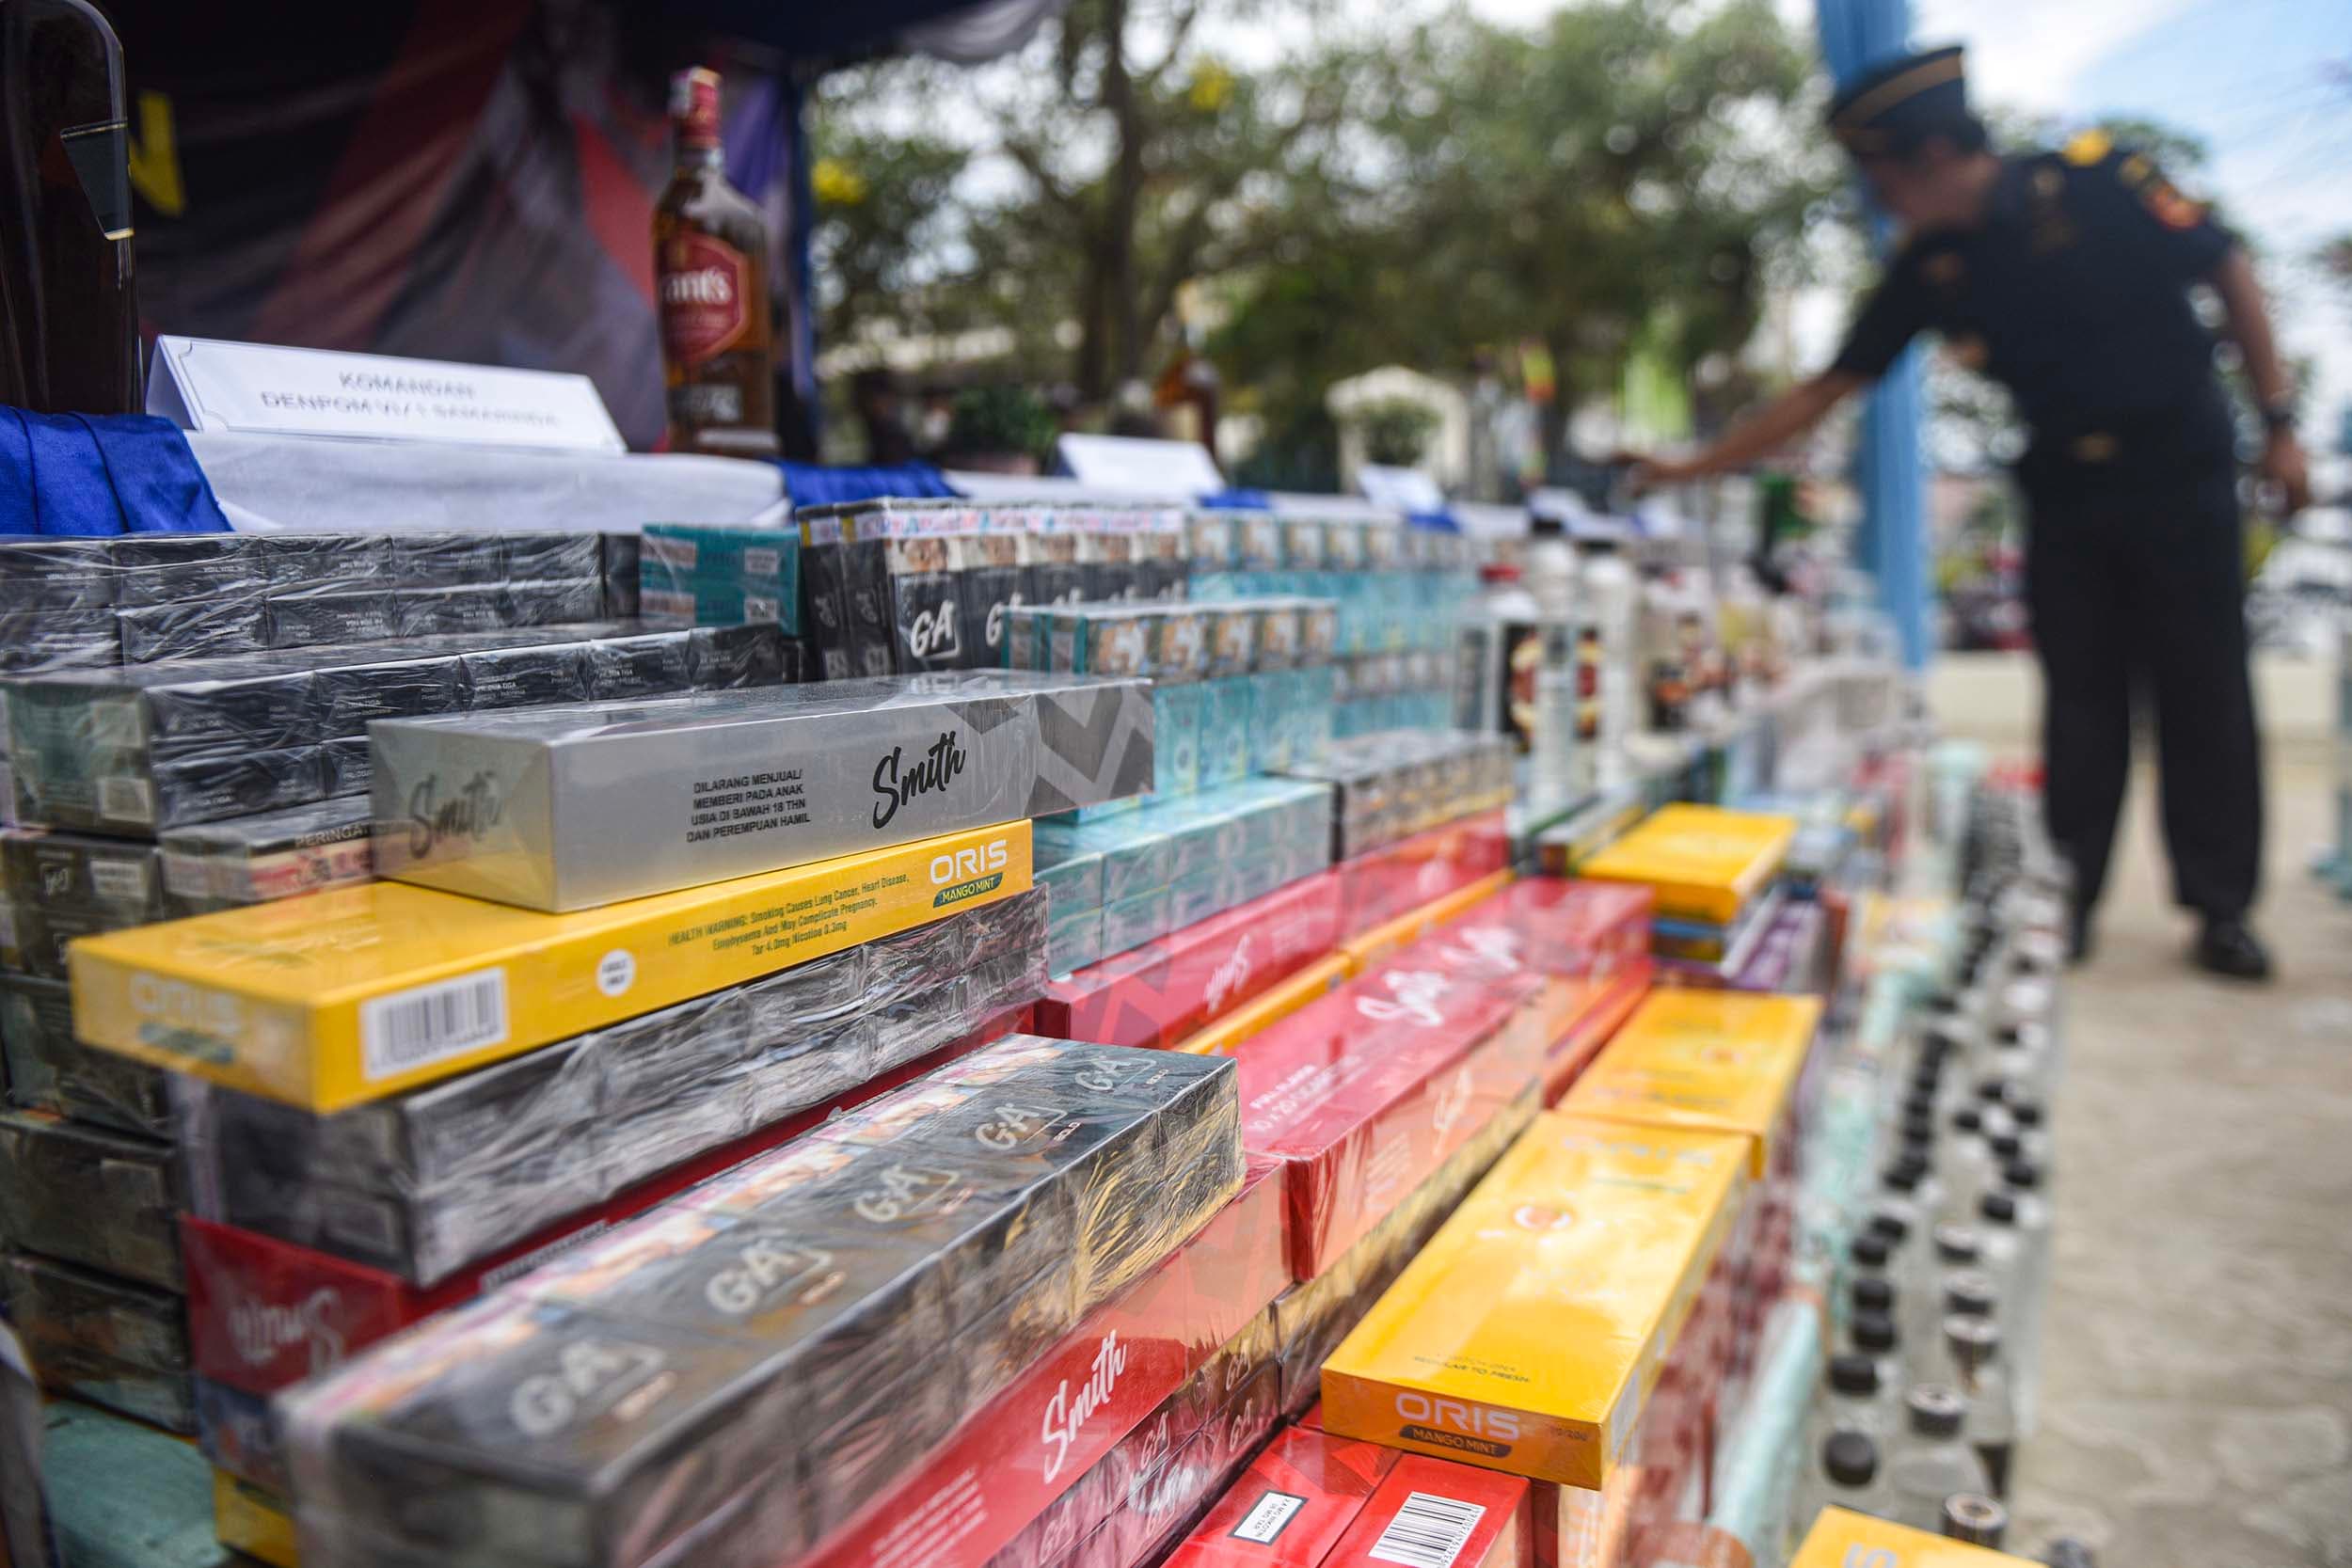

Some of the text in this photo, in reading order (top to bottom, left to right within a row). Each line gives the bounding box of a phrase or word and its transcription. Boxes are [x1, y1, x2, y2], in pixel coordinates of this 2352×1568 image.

[910, 600, 955, 659] GA
[692, 784, 803, 810] MEMBERI PADA ANAK
[693, 768, 803, 794] DILARANG MENJUAL/
[873, 731, 966, 829] Smith
[686, 813, 811, 843] DAN PEREMPUAN HAMIL
[691, 799, 806, 826] USIA DI BAWAH 18 THN
[930, 839, 1009, 884] ORIS
[751, 907, 785, 923] Smoking
[786, 898, 813, 914] Causes
[815, 894, 833, 906] Lung
[861, 880, 880, 894] Heart
[941, 877, 996, 903] MANGO MINT
[753, 943, 764, 956] Tar
[792, 927, 822, 943] Nicotine
[764, 924, 779, 935] And
[781, 919, 797, 931] May
[798, 908, 839, 927] Complicate
[976, 1102, 1040, 1150] GA
[853, 1164, 929, 1224] GA
[706, 1238, 795, 1314] GA
[1041, 1329, 1127, 1484] Smith
[1395, 1392, 1520, 1441] ORIS
[1413, 1428, 1499, 1455] MANGO MINT
